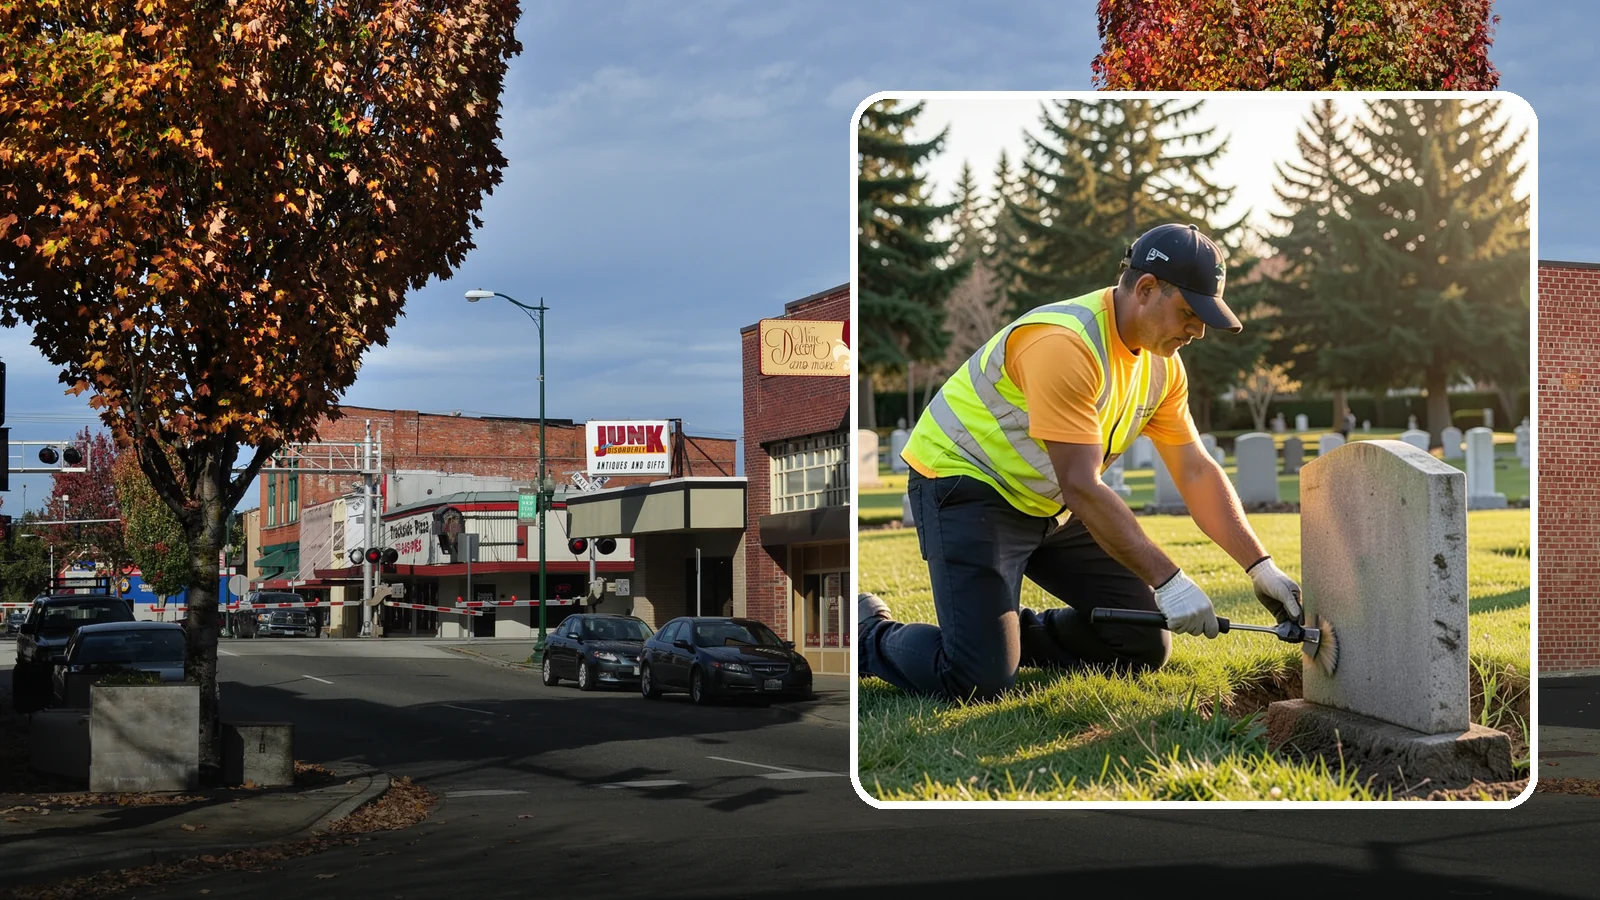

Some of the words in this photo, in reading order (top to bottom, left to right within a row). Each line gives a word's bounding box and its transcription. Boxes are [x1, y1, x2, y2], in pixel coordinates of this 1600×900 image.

[595, 425, 665, 457] JUNK
[607, 445, 646, 454] DISORDERLY
[597, 461, 628, 470] ANTIQUES
[631, 461, 644, 470] AND
[647, 460, 665, 469] GIFTS
[414, 519, 429, 535] Pizza
